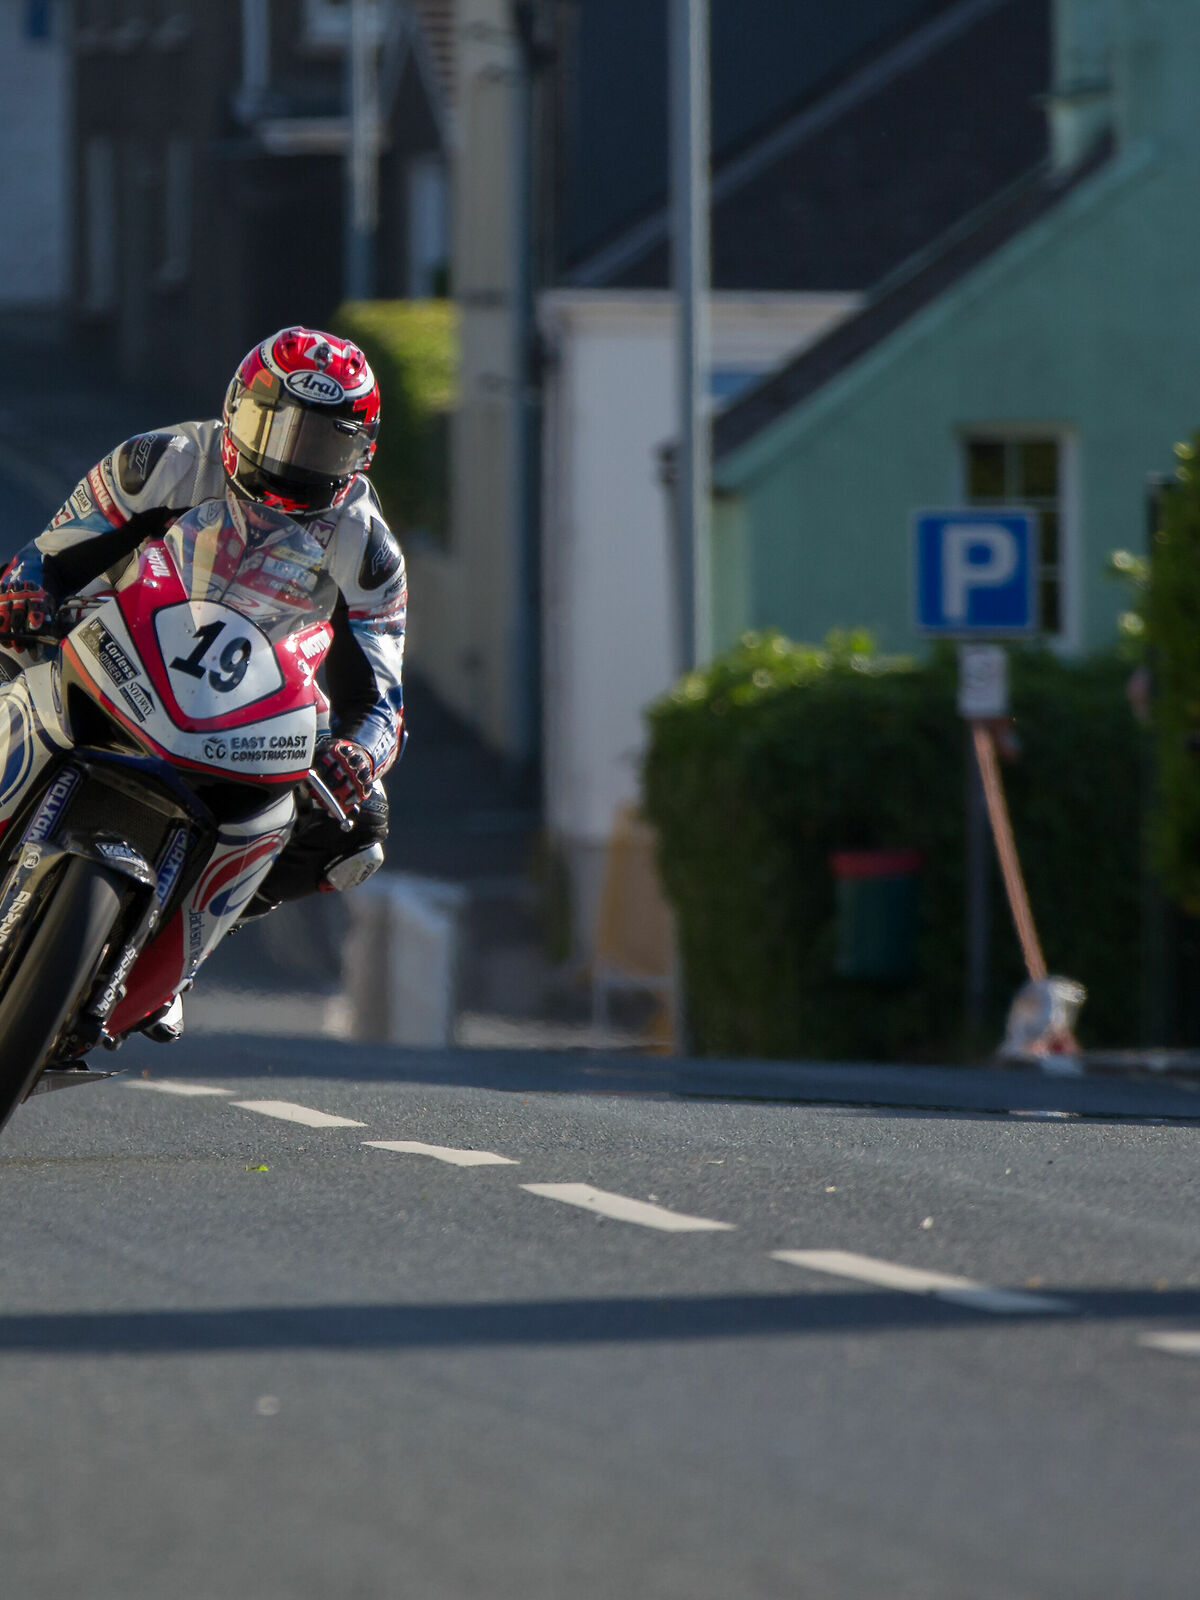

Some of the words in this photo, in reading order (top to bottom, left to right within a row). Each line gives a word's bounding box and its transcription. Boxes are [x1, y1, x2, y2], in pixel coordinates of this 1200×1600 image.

[292, 373, 338, 397] Arai
[941, 523, 1018, 618] P
[99, 650, 125, 685] JOINERY
[105, 641, 134, 680] Corless
[169, 620, 252, 693] 19
[126, 681, 155, 717] SOLWAY
[230, 736, 266, 749] EAST
[269, 735, 308, 748] COAST
[230, 750, 307, 762] CONSTRUCTION
[27, 770, 76, 843] MAXTON
[155, 833, 188, 901] MAXTO
